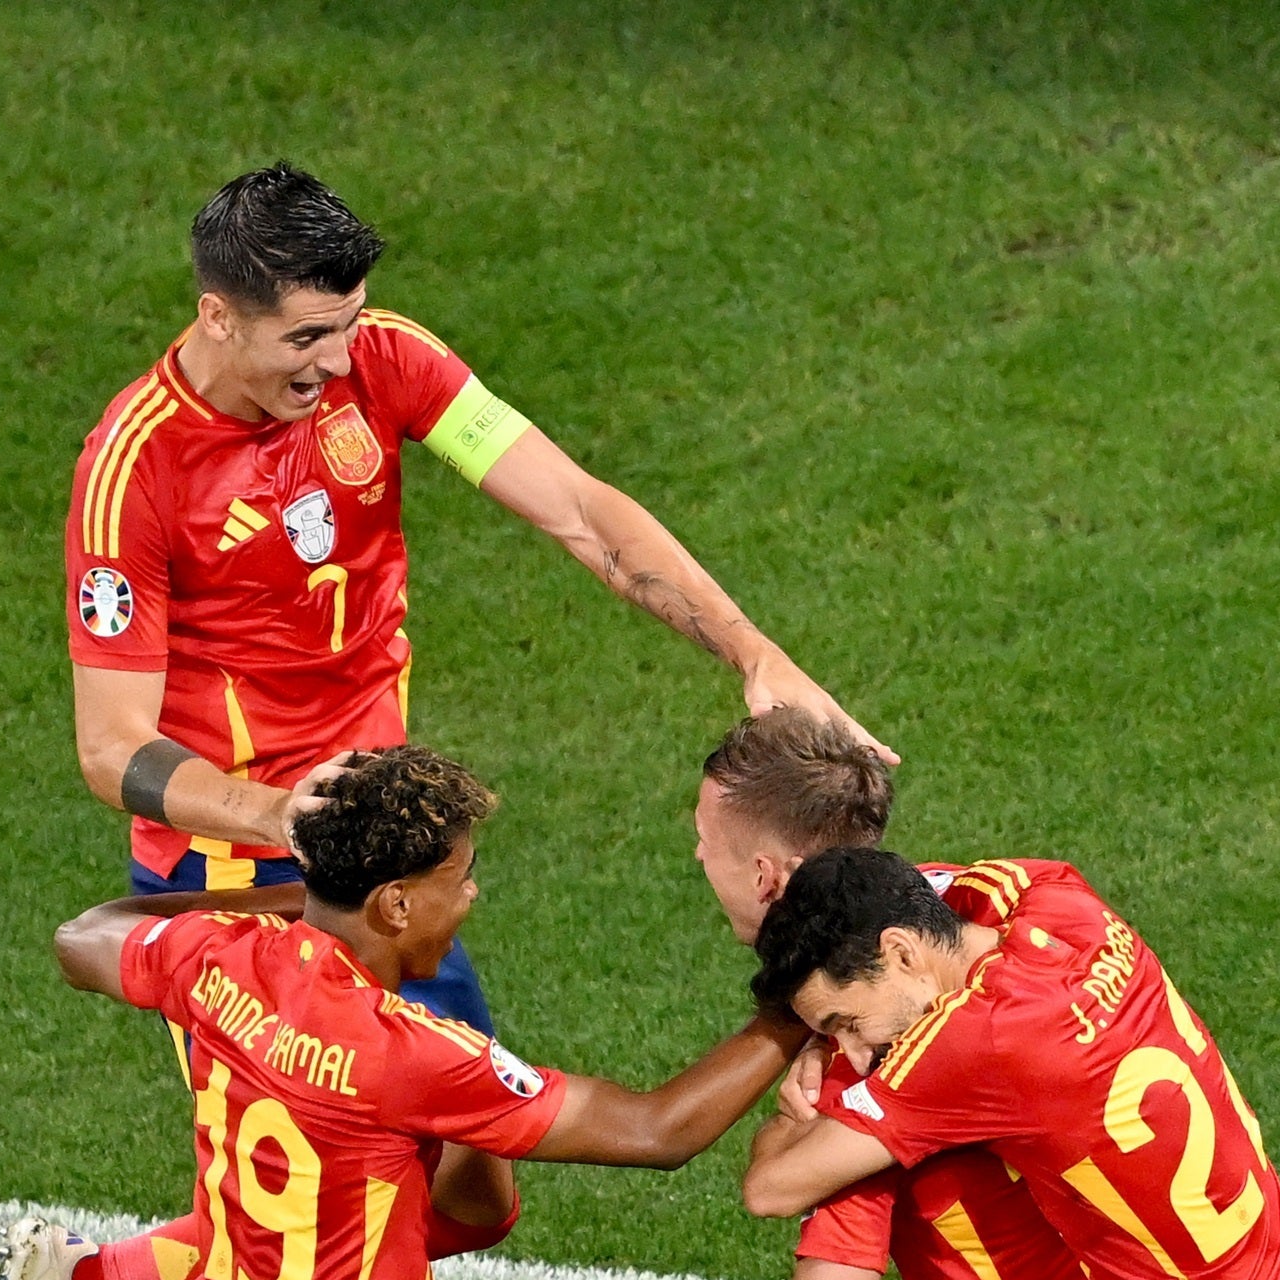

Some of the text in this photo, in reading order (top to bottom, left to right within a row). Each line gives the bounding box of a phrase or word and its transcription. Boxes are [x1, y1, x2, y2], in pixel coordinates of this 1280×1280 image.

[308, 564, 348, 653] 7
[190, 963, 357, 1097] LAMINE YAMAL
